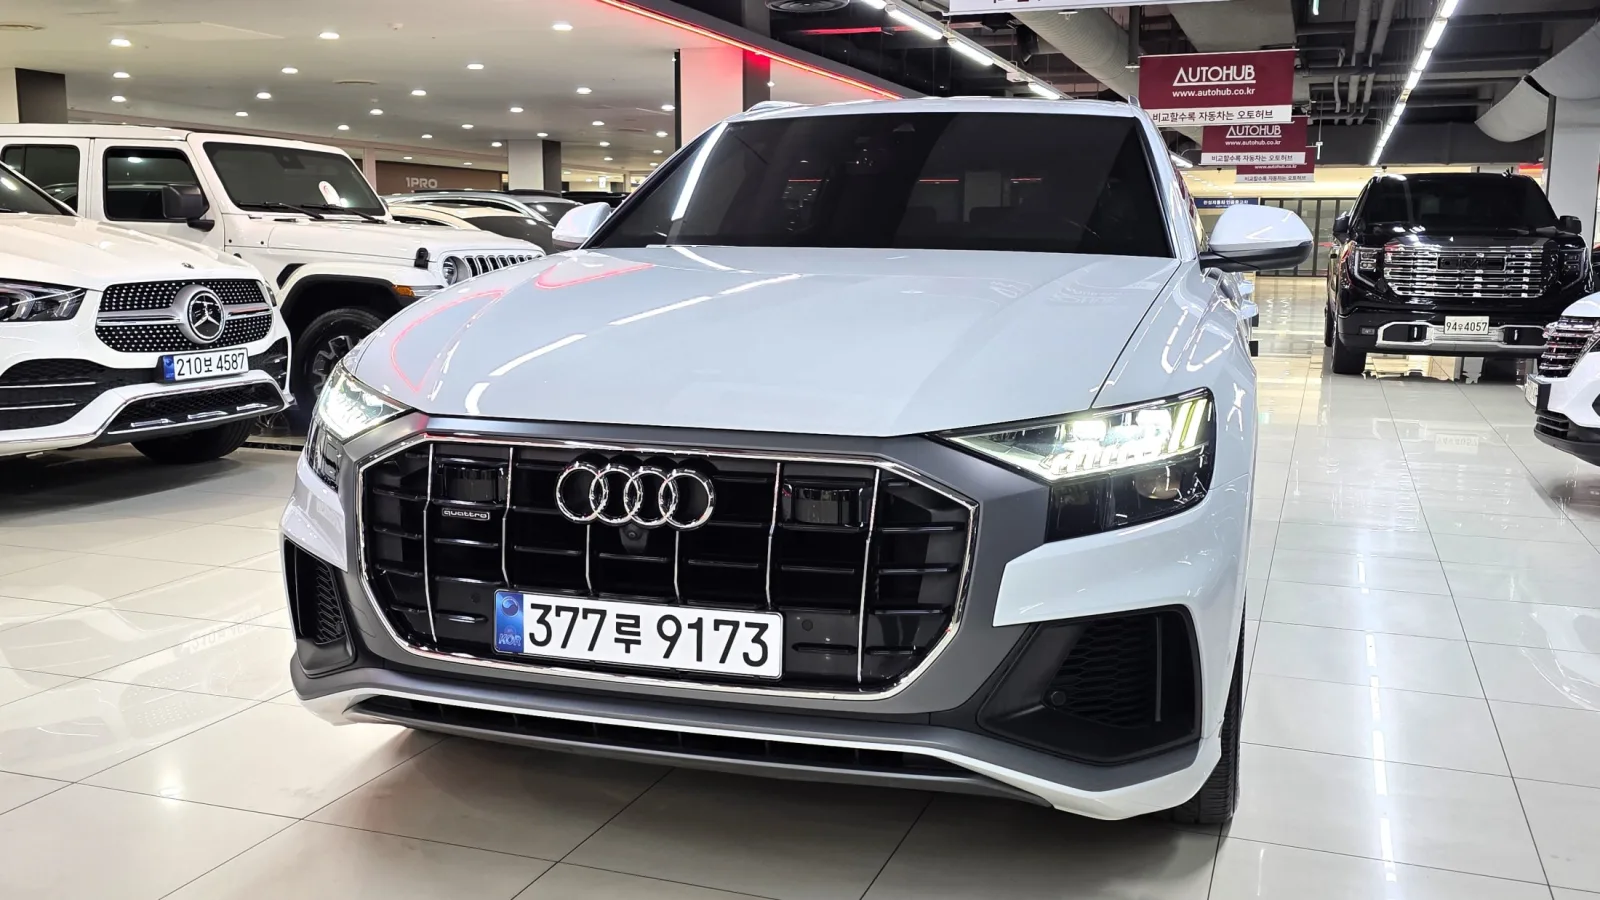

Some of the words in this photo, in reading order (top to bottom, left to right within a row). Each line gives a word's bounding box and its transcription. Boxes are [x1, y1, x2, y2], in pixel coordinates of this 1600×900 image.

[1172, 65, 1256, 86] AUTOHUB
[1172, 87, 1255, 97] www.autohub.co.kr
[1152, 112, 1197, 123] 비교할수록
[1199, 111, 1235, 121] 자동차는
[1237, 109, 1274, 120] 오토허브
[1225, 125, 1282, 138] AUTOHUB
[405, 176, 438, 189] 1PRO
[176, 357, 213, 376] 210보
[216, 353, 245, 371] 4587
[443, 510, 488, 519] quattro
[498, 633, 522, 646] KOR
[528, 603, 642, 654] 377루
[656, 614, 770, 668] 9173
